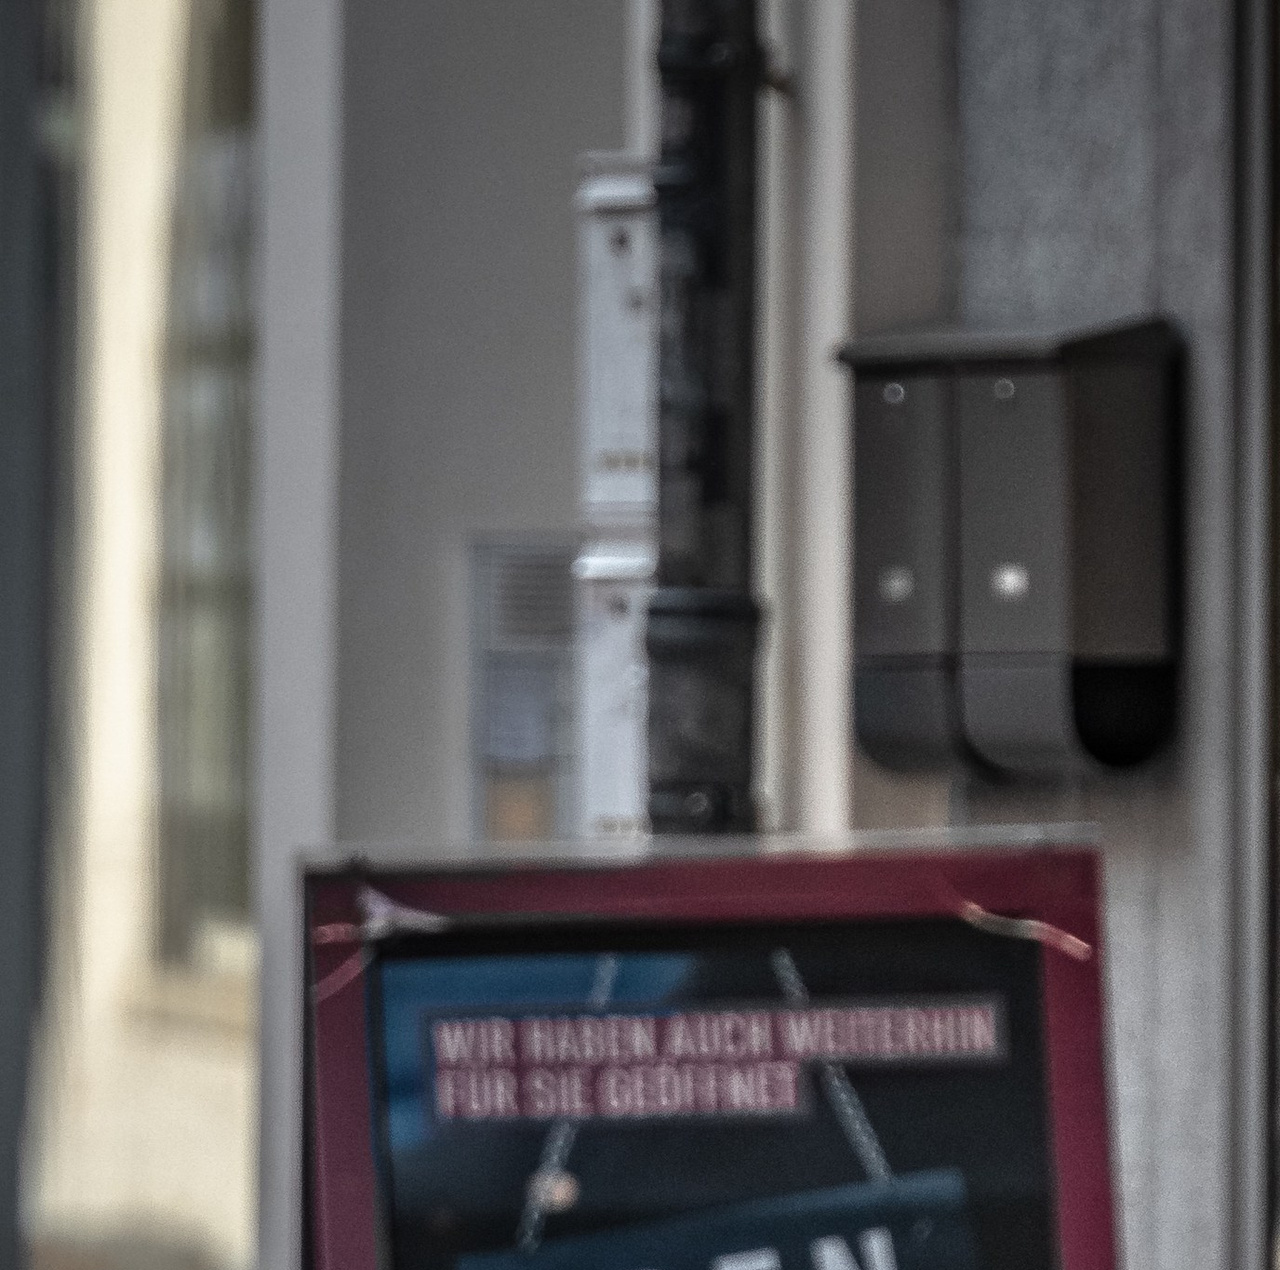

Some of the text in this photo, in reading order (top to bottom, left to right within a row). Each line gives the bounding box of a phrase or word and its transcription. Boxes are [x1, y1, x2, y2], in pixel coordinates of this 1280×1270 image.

[438, 1006, 997, 1063] WIR HABEN AUCH WEITERHIN
[528, 1068, 594, 1114] SIE
